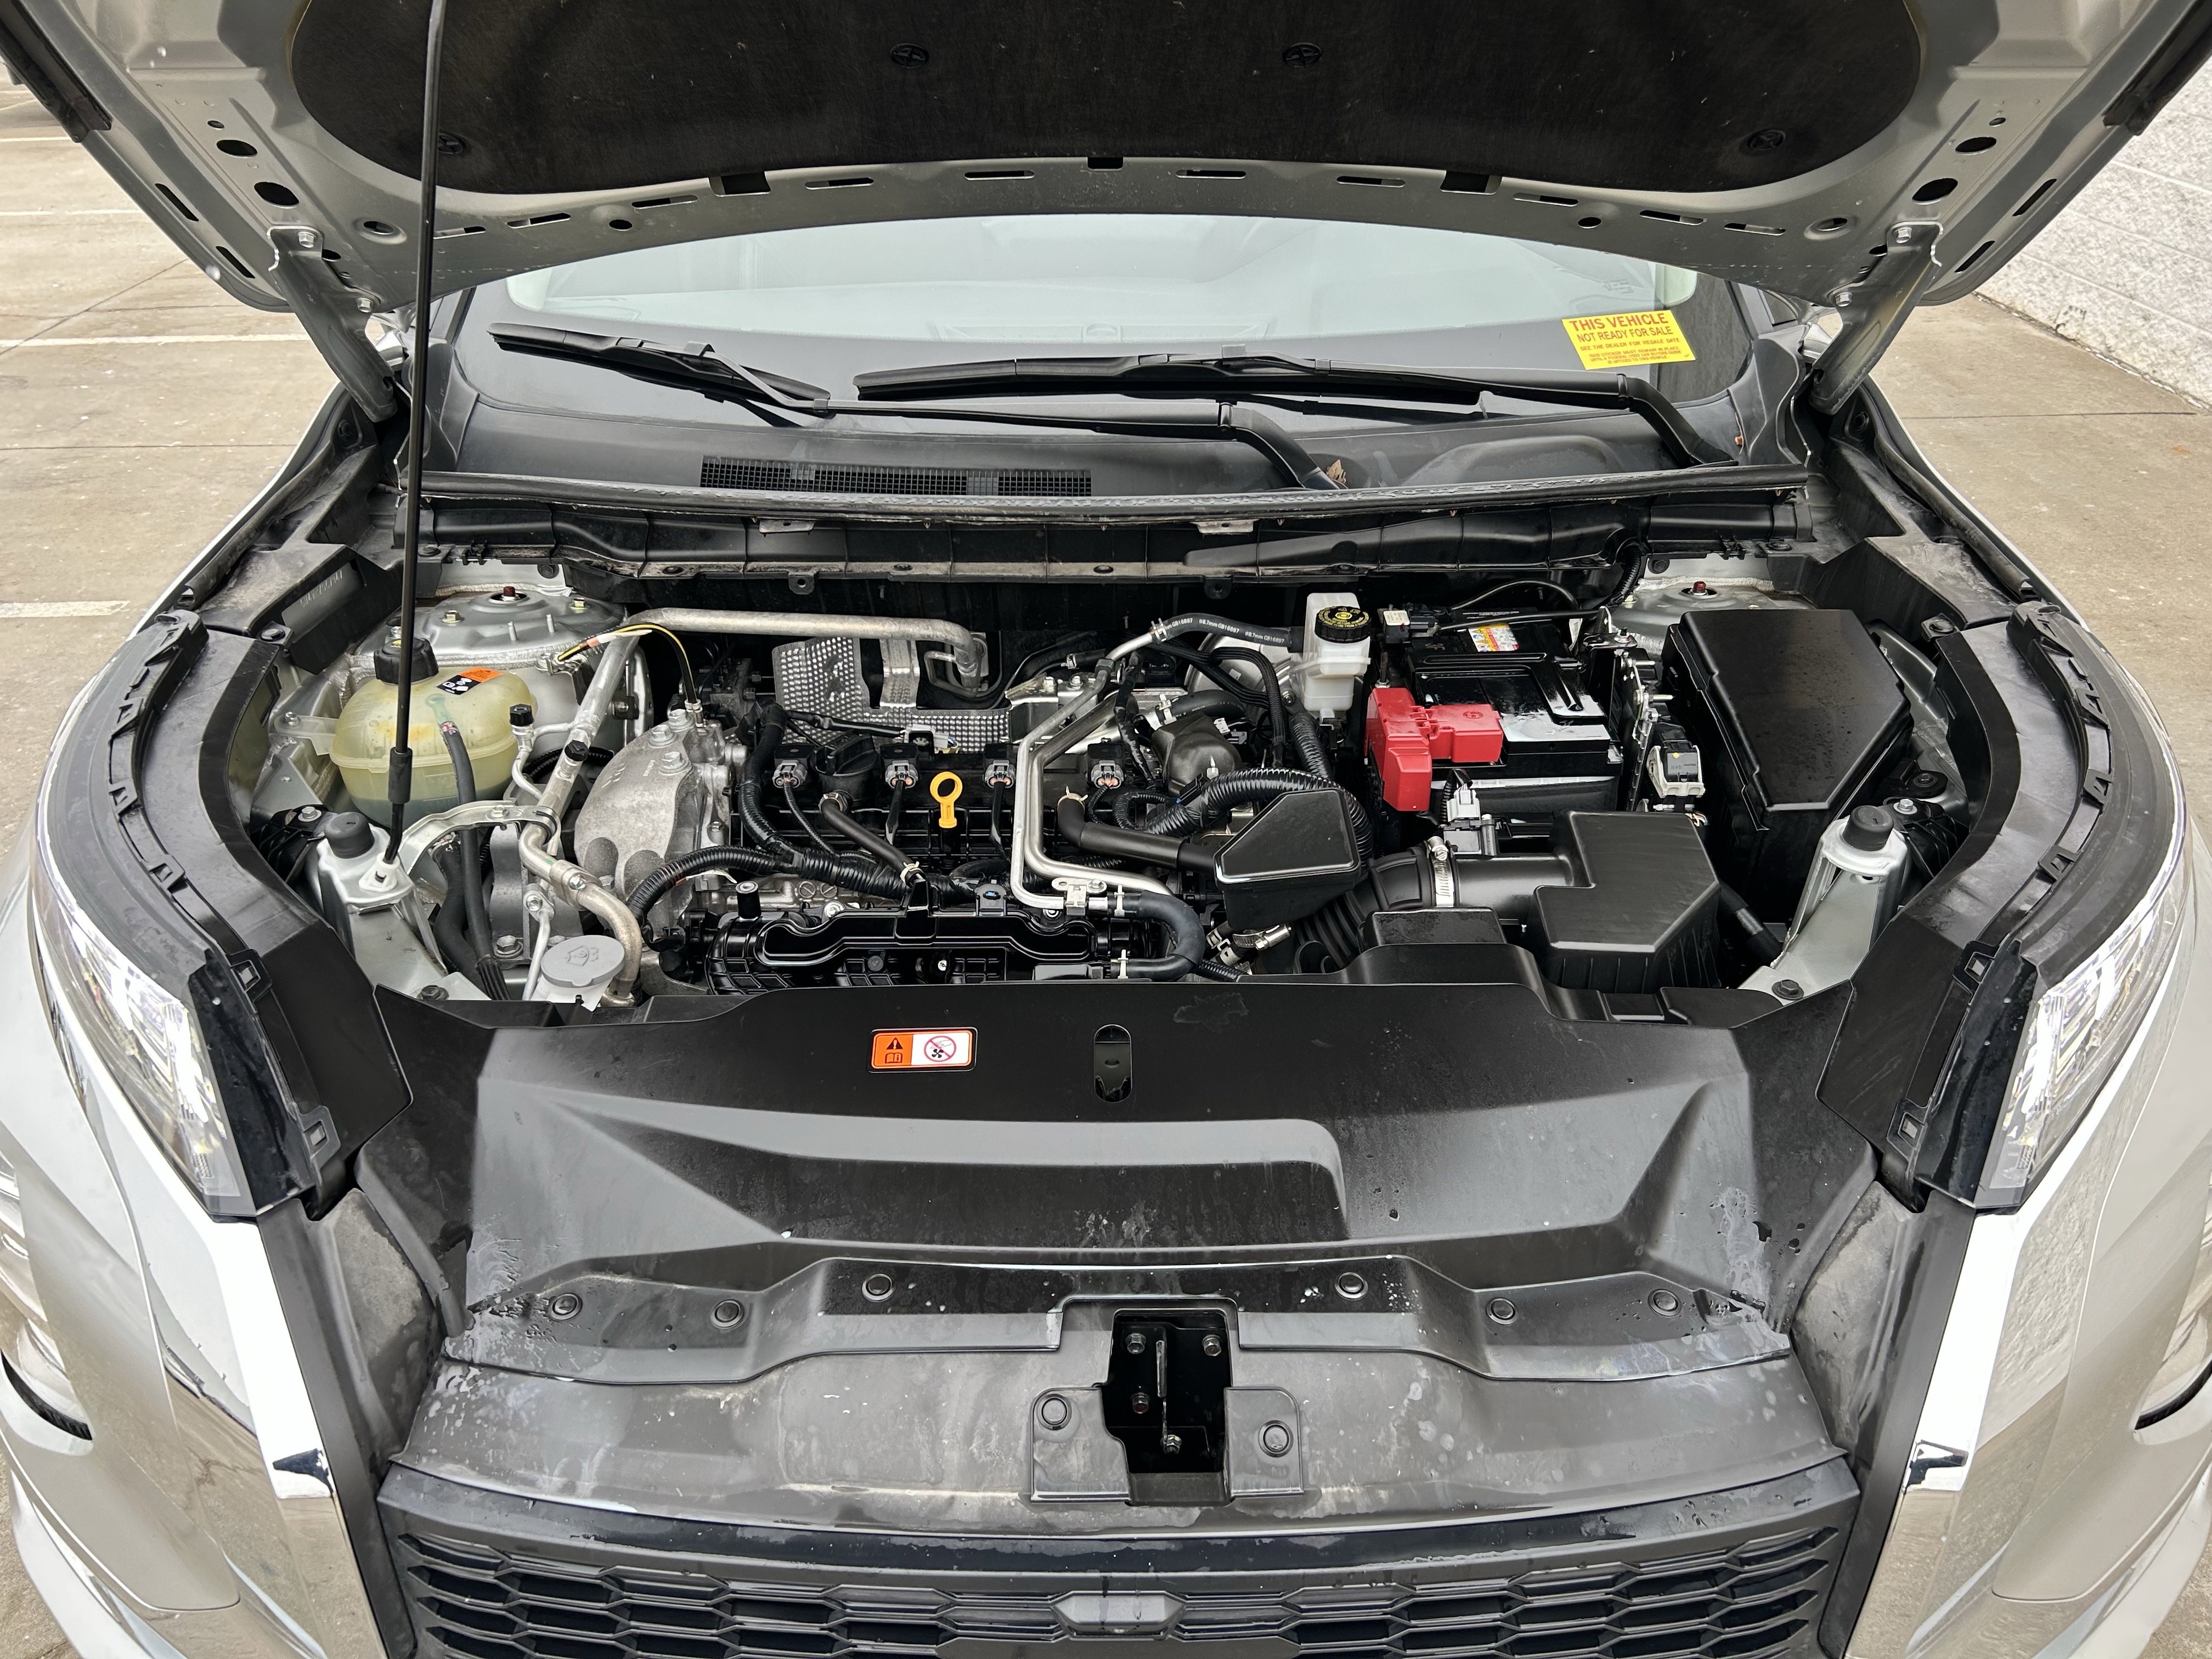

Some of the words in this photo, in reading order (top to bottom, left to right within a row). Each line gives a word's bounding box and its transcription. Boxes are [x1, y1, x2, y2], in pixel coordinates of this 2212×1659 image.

[1569, 318, 1605, 331] THIS
[1605, 313, 1668, 328] VEHICLE
[1577, 332, 1596, 342] NOT
[1597, 330, 1628, 340] READY
[1629, 328, 1649, 337] FOR
[1649, 326, 1673, 336] SALE
